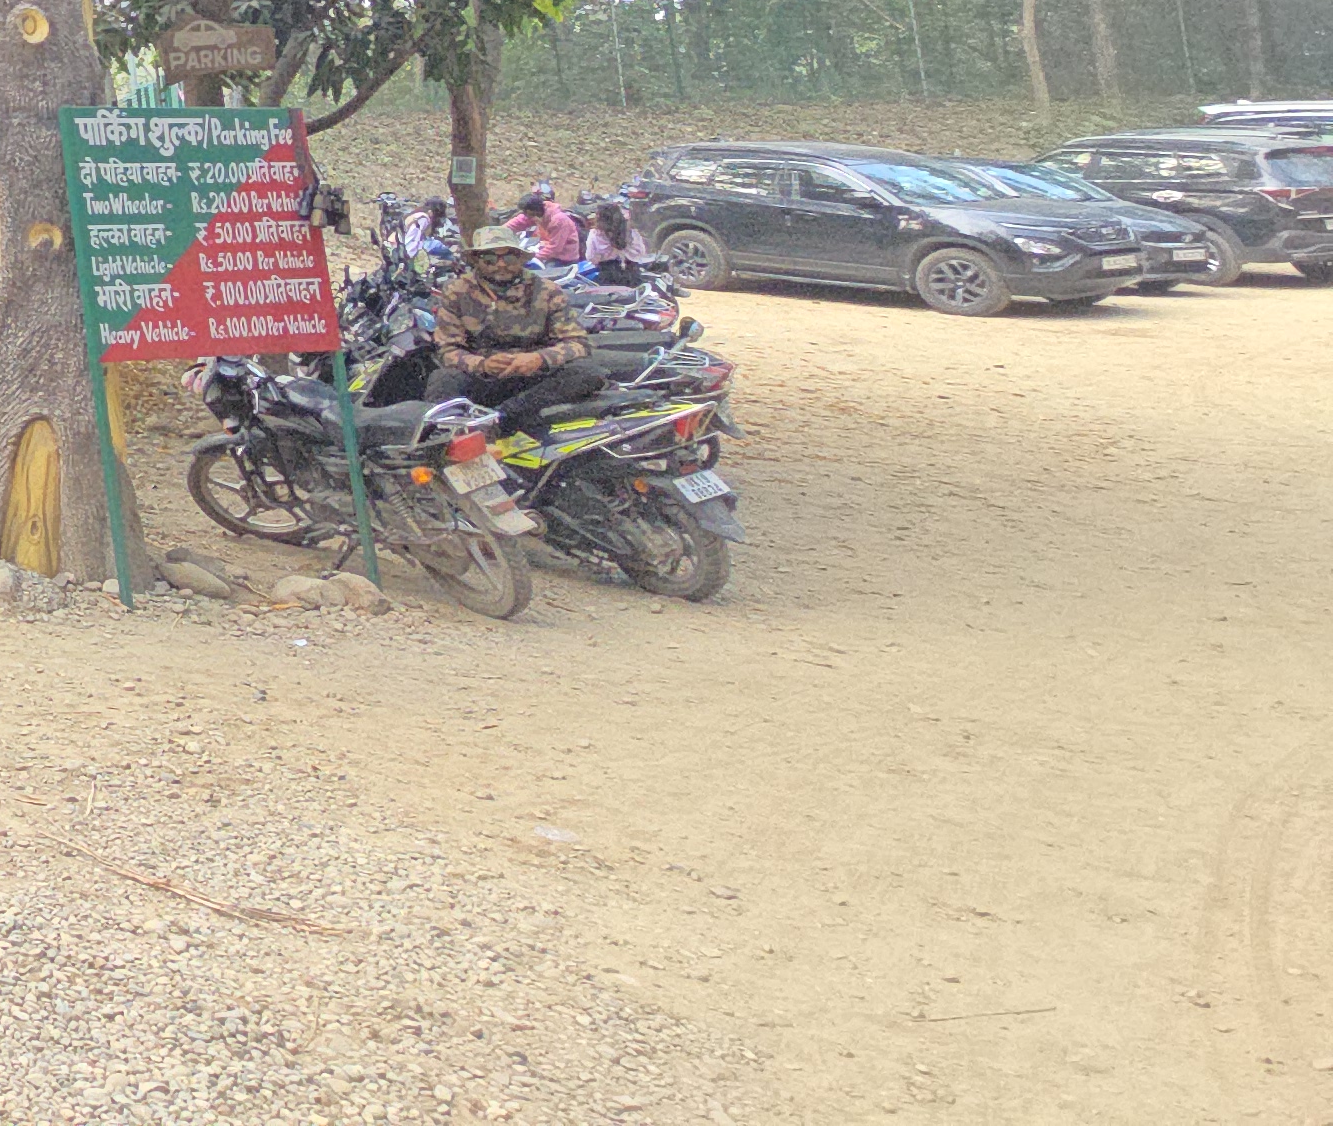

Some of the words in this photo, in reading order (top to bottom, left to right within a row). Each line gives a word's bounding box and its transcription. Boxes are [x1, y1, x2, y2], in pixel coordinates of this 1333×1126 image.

[169, 47, 262, 70] PARKING
[269, 118, 293, 145] Fee
[79, 157, 97, 188] दो
[98, 158, 141, 186] पहिया
[246, 158, 270, 183] प्रति
[251, 191, 268, 212] Per
[87, 224, 129, 249] हल्का
[254, 217, 278, 243] प्रति
[278, 221, 311, 244] वाहन
[257, 250, 274, 270] Per
[275, 250, 314, 270] Vehicle
[94, 278, 132, 312] भारी
[263, 274, 287, 304] प्रति
[285, 278, 322, 304] वाहन
[99, 321, 140, 350] Heavy
[267, 315, 284, 336] Per
[284, 313, 326, 335] Vehicle
